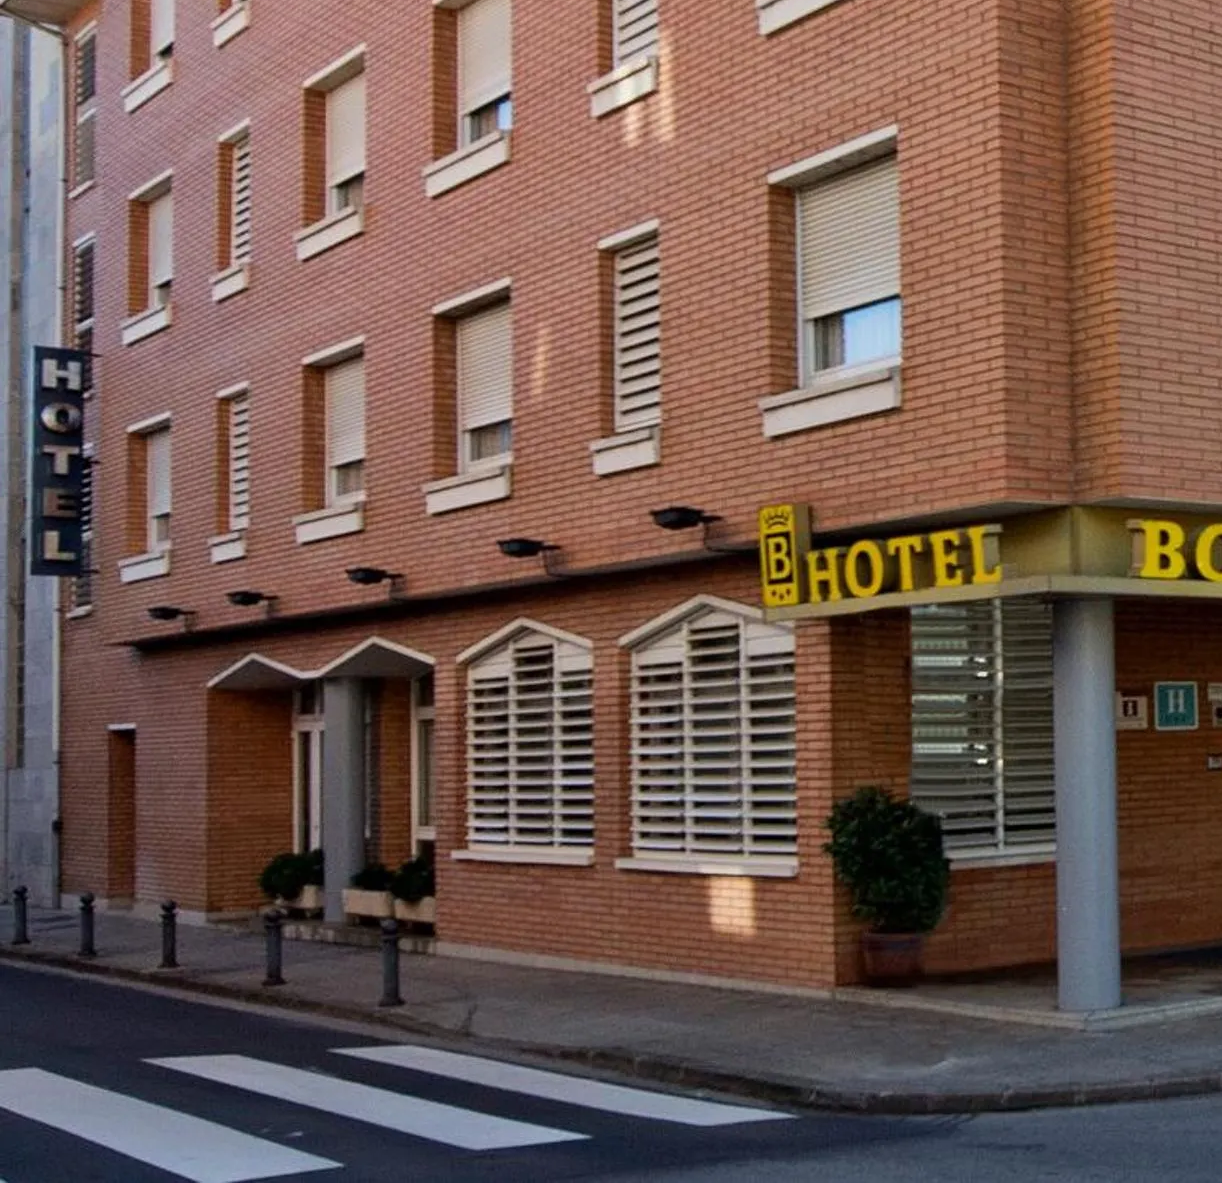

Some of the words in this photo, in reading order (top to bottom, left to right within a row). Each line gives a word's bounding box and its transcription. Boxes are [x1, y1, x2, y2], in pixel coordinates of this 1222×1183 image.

[41, 358, 82, 561] HOTEL
[767, 536, 792, 580] B
[806, 525, 1003, 604] HOTEL
